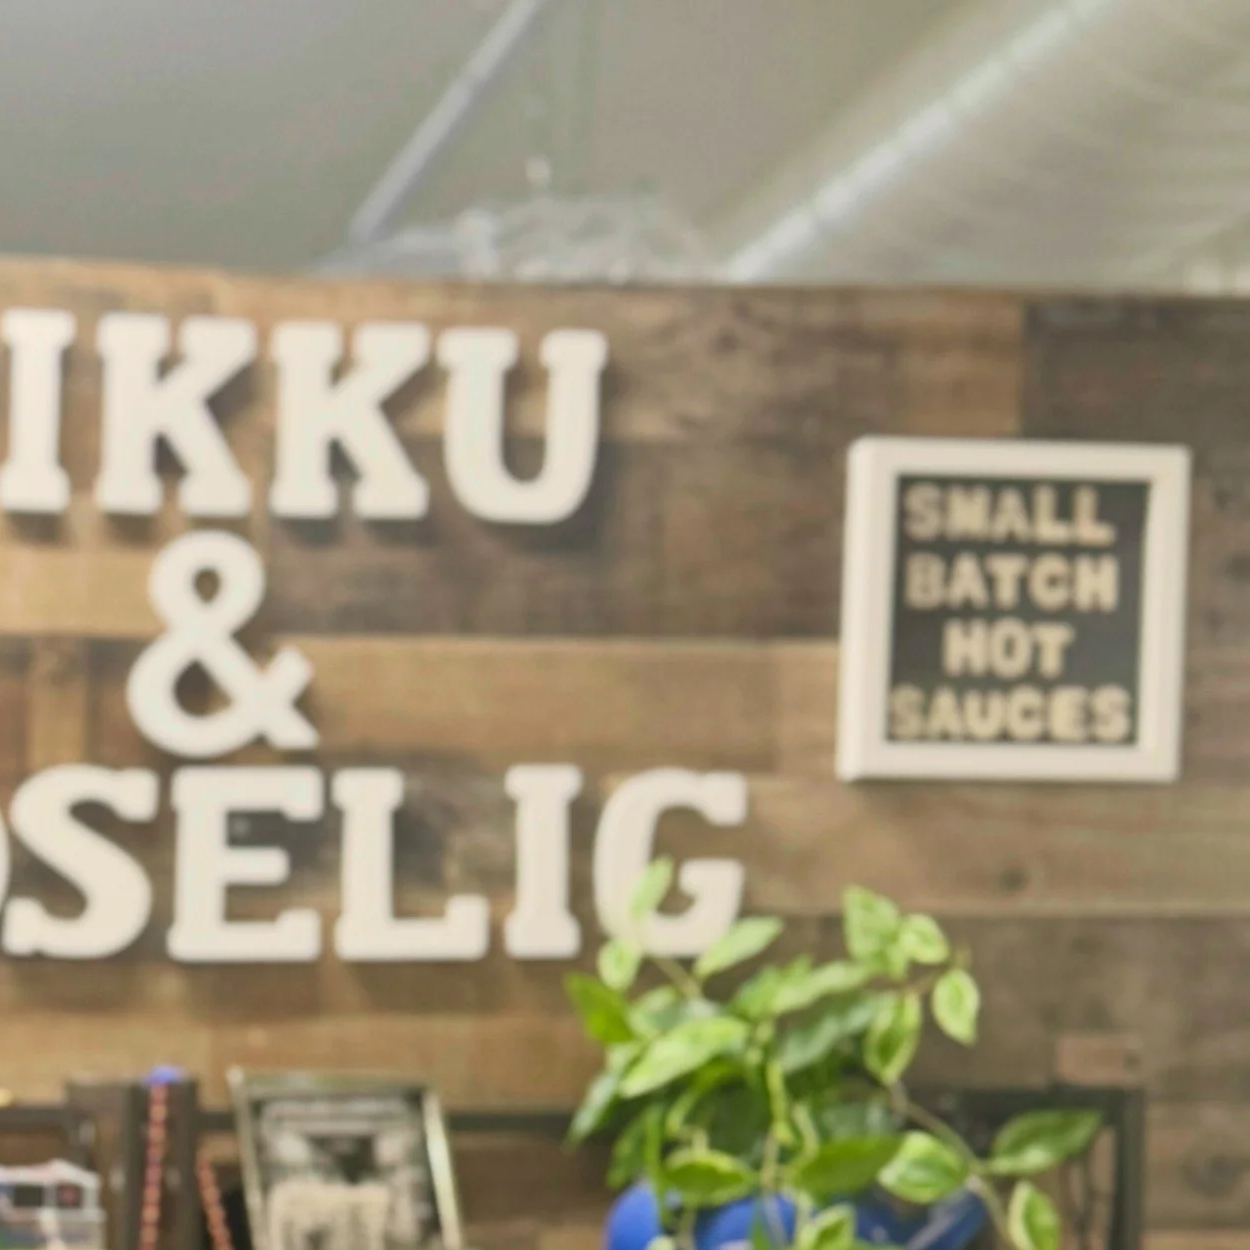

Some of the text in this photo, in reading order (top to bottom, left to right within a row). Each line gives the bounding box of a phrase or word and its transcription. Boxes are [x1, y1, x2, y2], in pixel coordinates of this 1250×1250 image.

[905, 482, 1116, 547] SMALL
[904, 552, 1119, 611] BATCH
[126, 530, 319, 757] &
[942, 617, 1075, 679] HOT
[890, 683, 1130, 742] SAUCES
